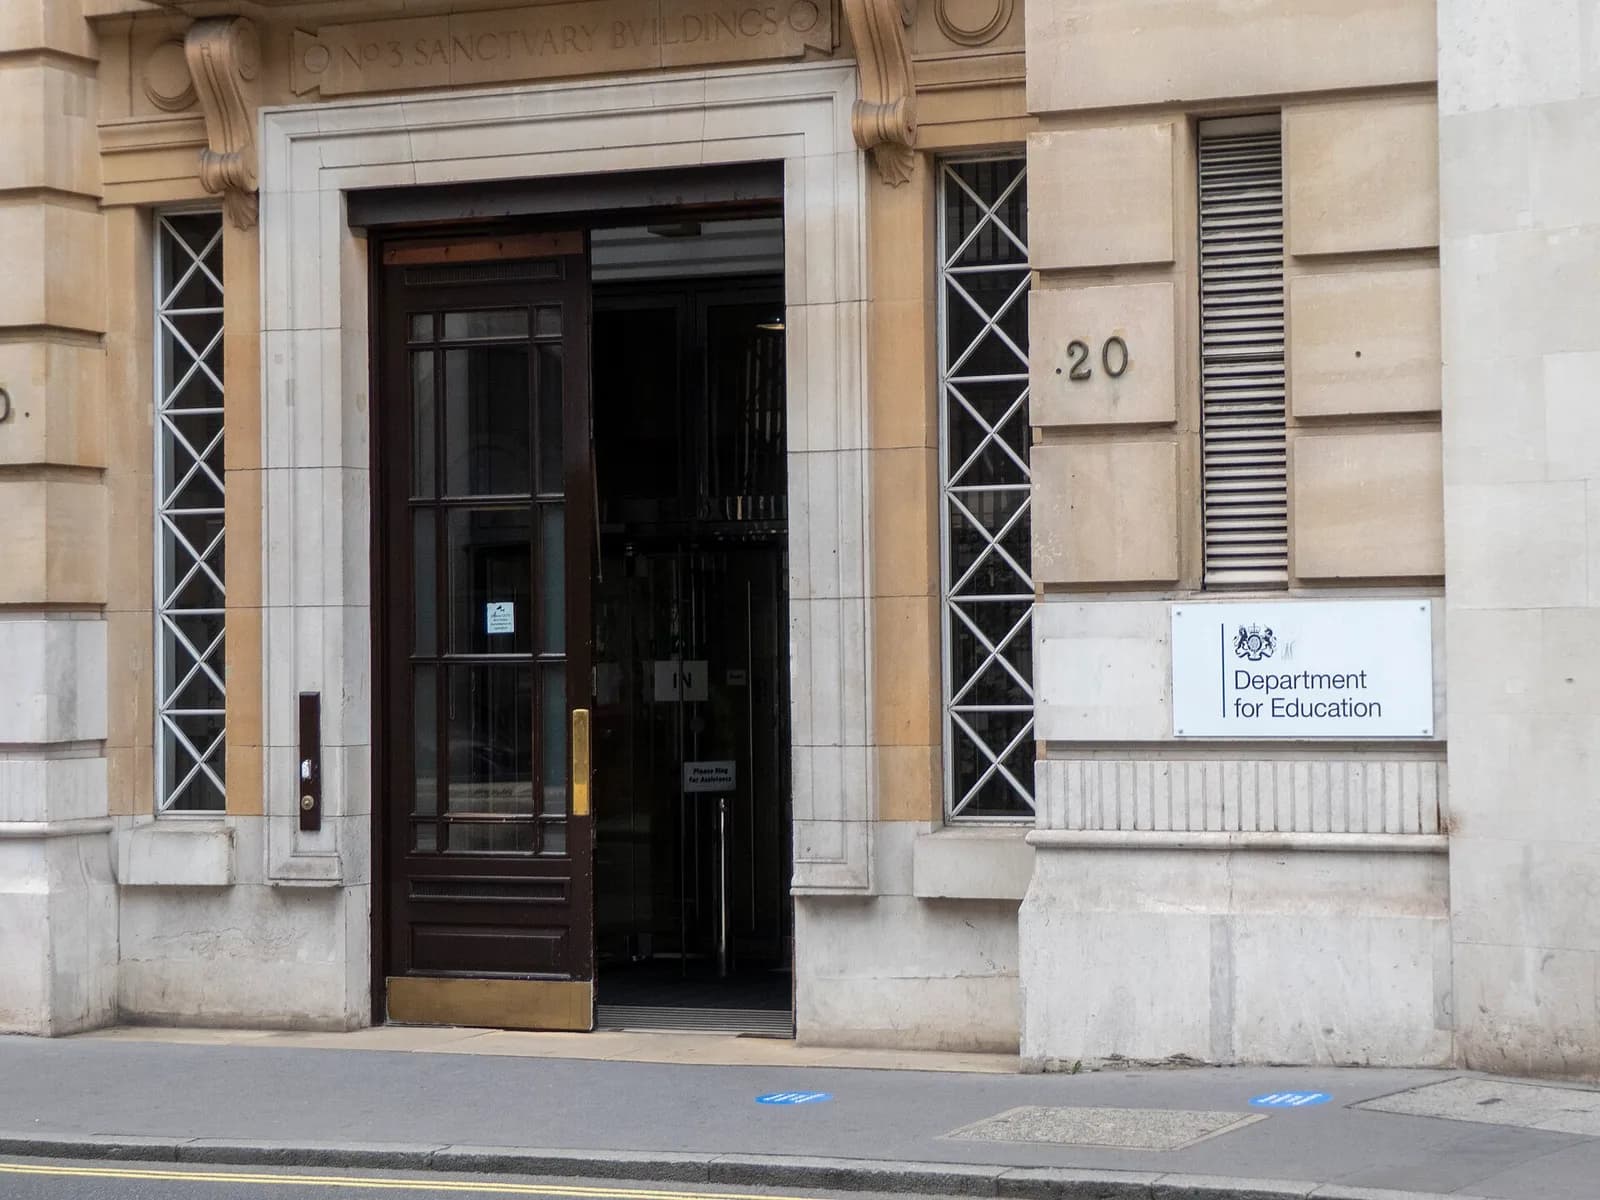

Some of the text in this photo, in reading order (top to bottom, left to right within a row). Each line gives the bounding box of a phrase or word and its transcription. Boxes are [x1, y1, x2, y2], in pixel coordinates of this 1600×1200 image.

[673, 672, 692, 688] IN
[1234, 669, 1368, 694] Department
[1234, 697, 1382, 718] for Education
